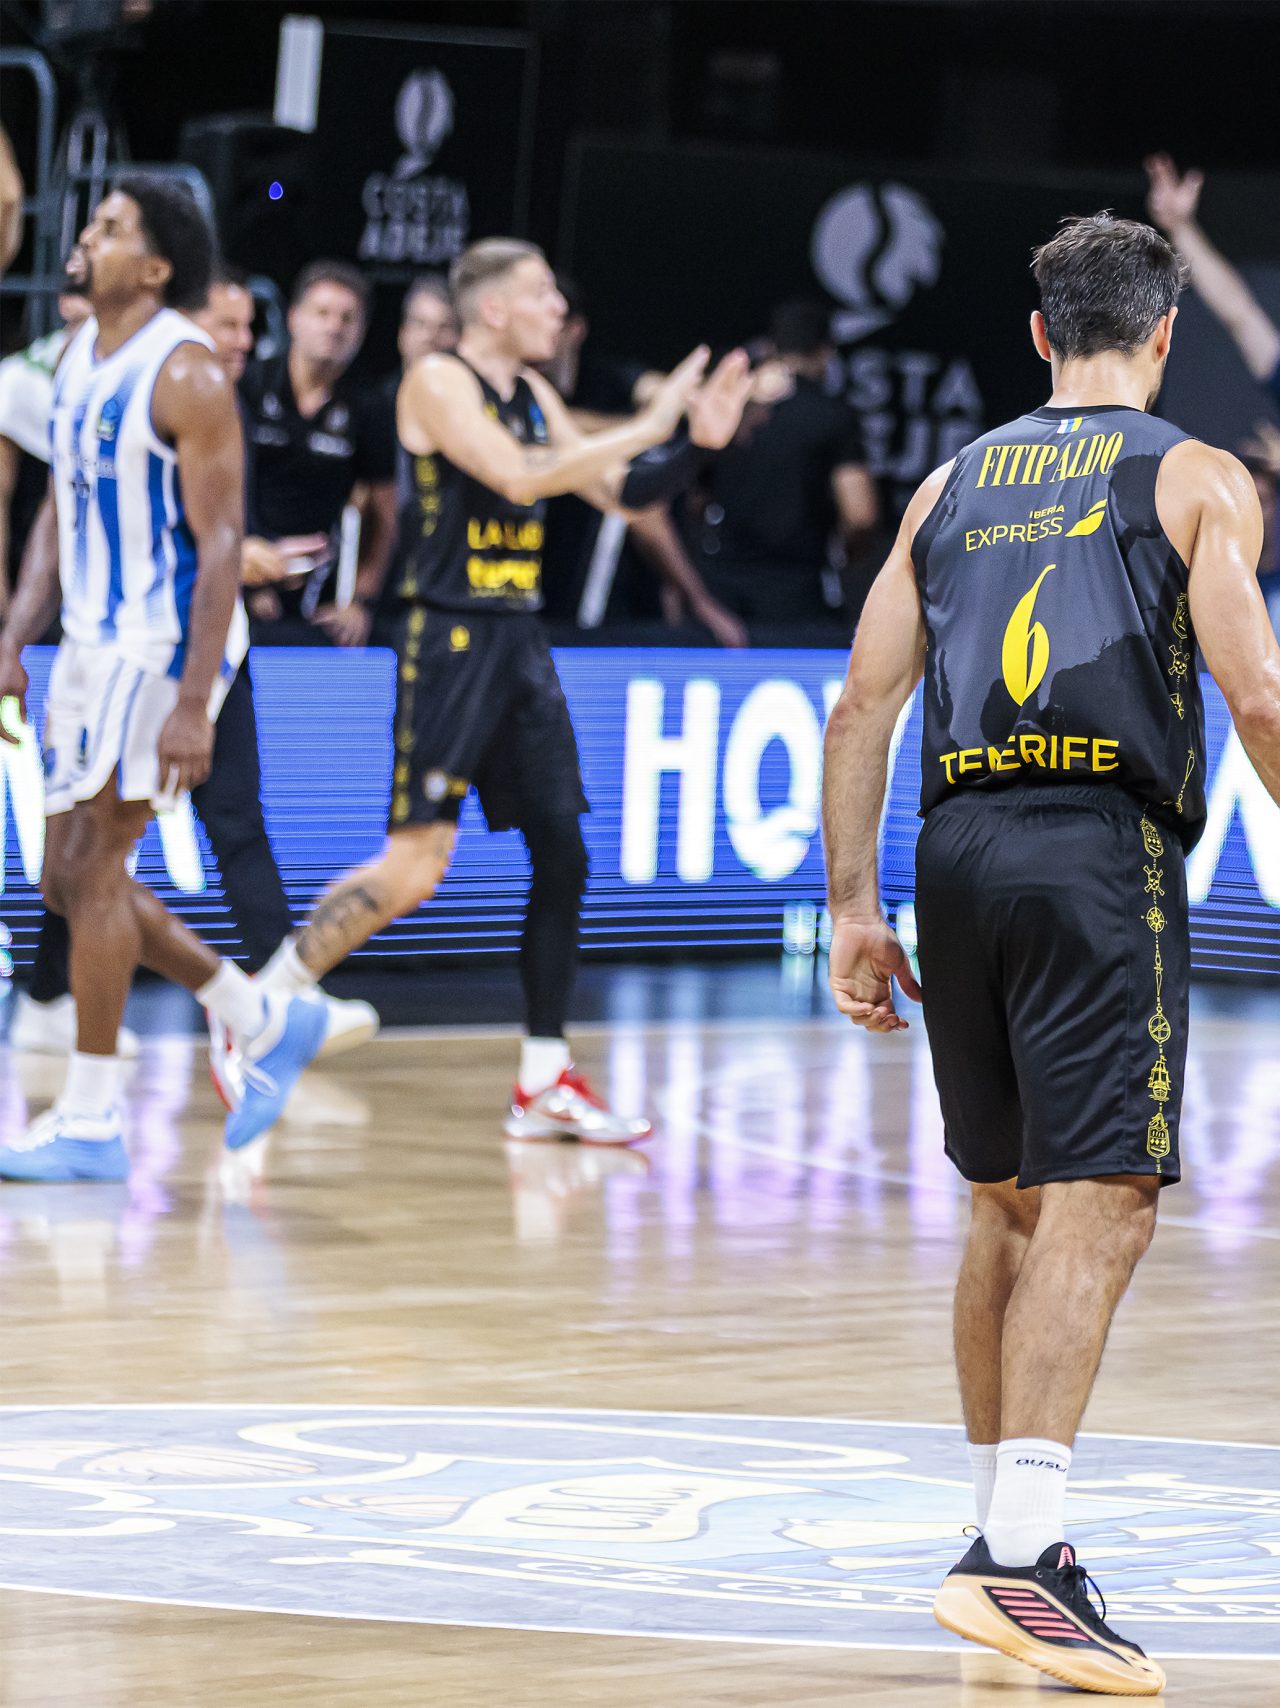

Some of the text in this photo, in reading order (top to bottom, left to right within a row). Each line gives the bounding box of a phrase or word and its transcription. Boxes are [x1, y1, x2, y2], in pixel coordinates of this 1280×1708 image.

[975, 431, 1124, 488] FITIPALDO
[965, 517, 1064, 551] EXPRESS
[1029, 504, 1066, 519] IBERIA
[1002, 564, 1057, 707] 6
[940, 734, 1120, 784] TENERIFE
